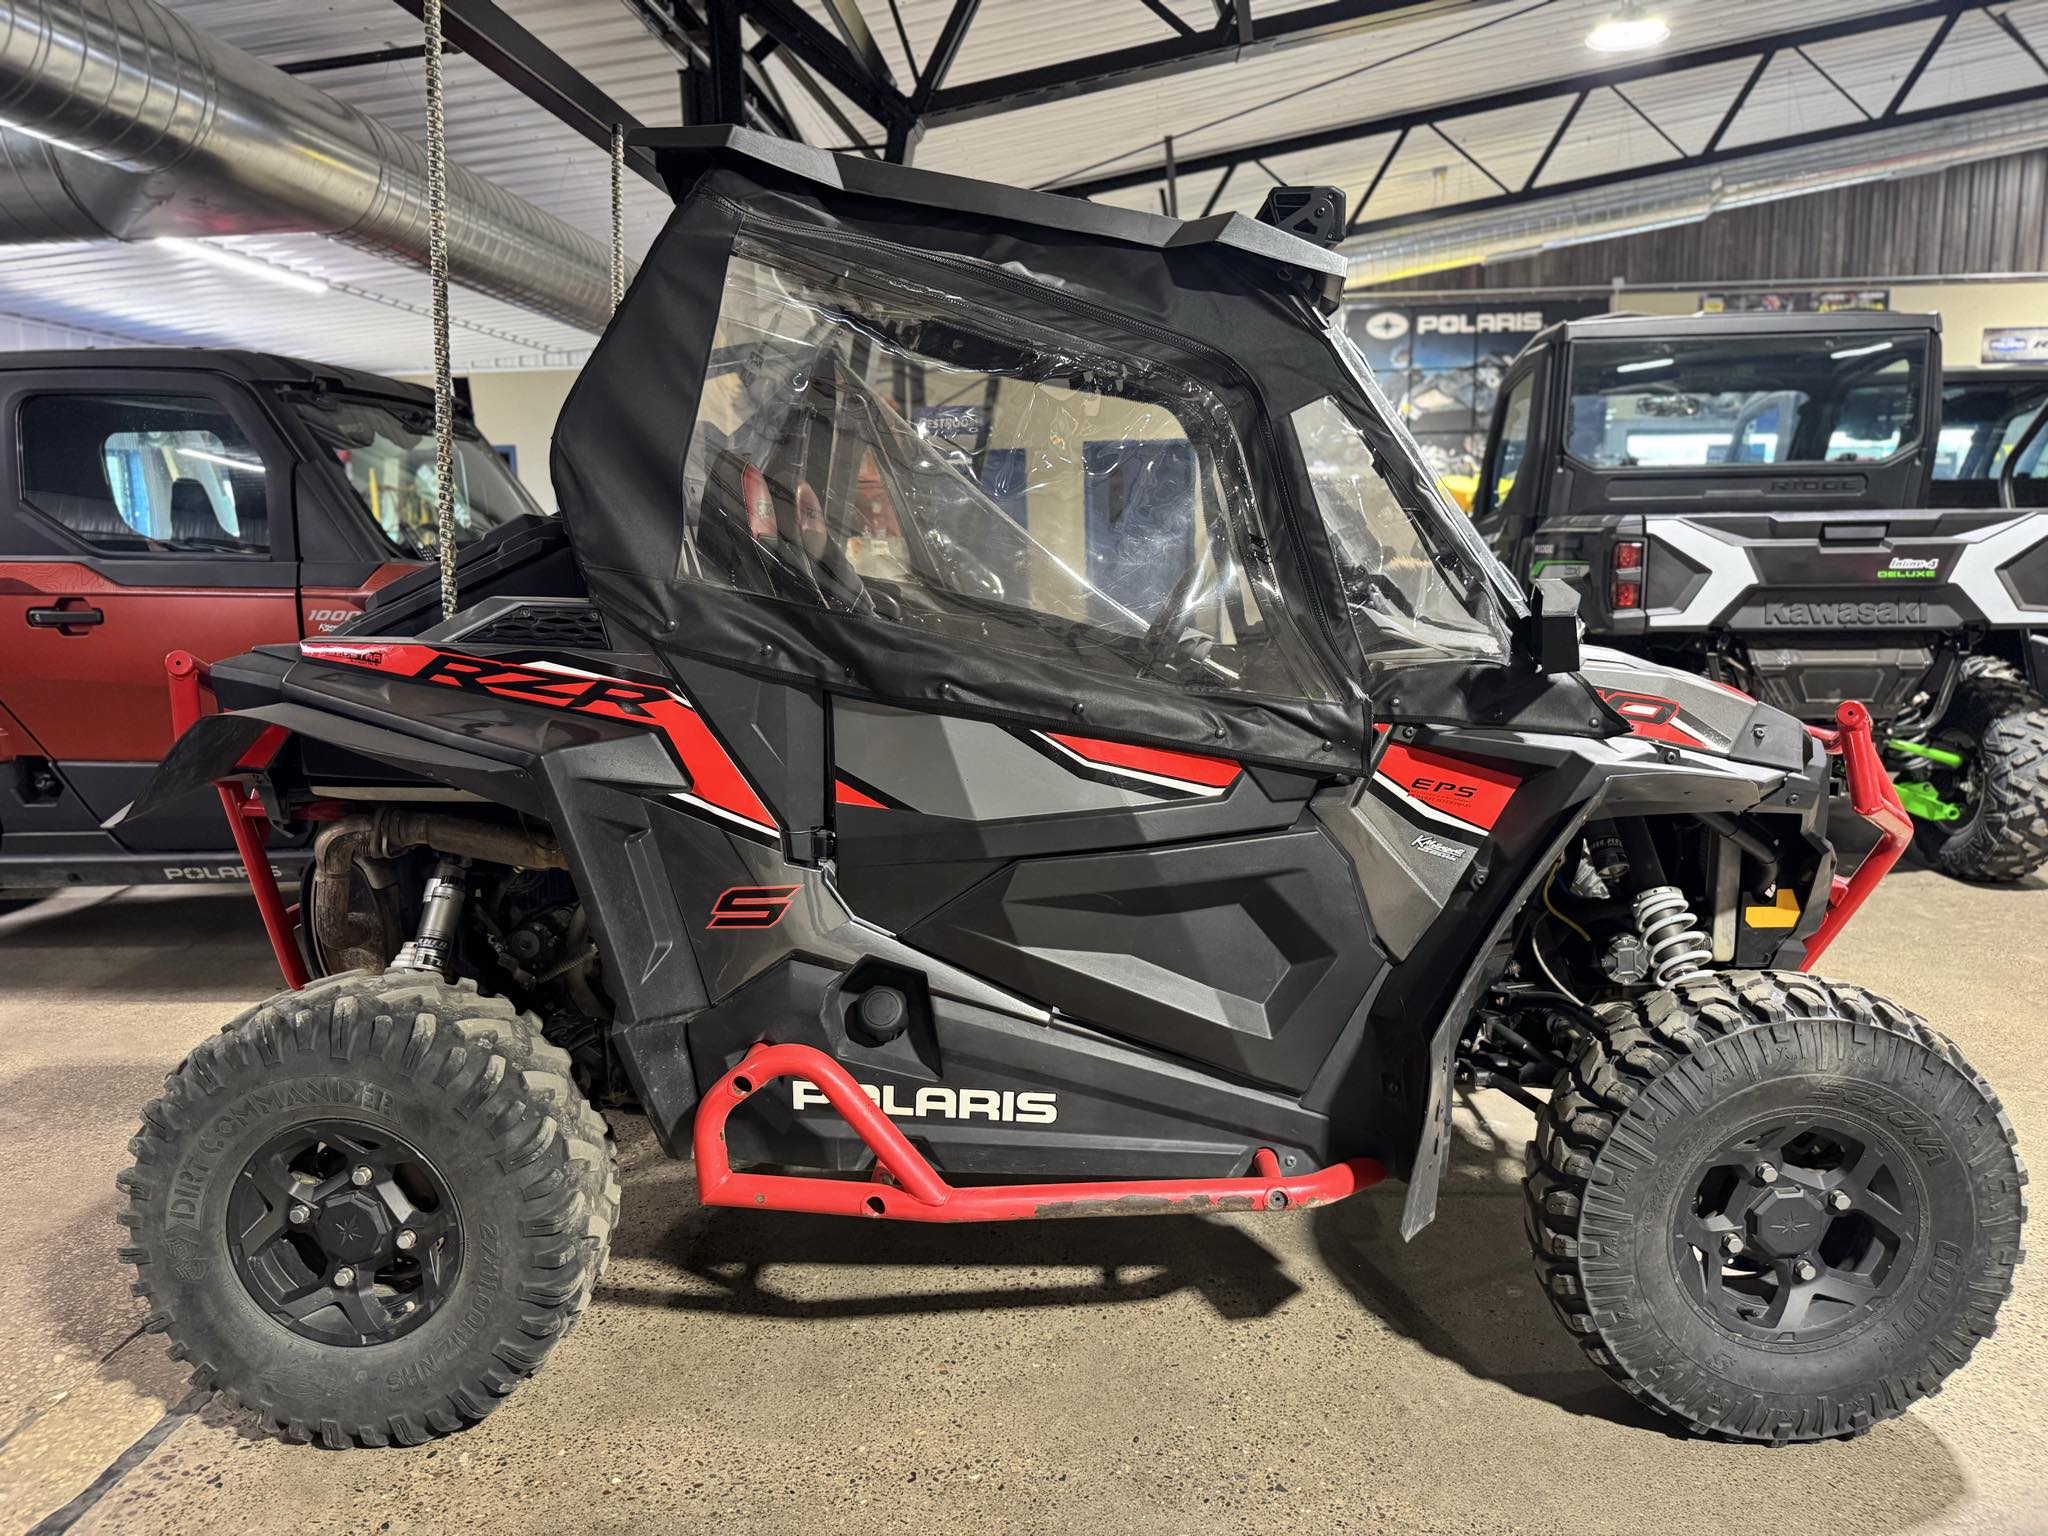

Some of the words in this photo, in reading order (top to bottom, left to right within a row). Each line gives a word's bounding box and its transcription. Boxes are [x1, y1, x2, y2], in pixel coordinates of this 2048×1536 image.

[1417, 311, 1543, 334] POLARIS
[1770, 479, 1857, 491] RIDGE
[1877, 570, 1937, 578] DELUXE
[1764, 600, 1928, 625] Kawasaki
[414, 653, 674, 718] RZR
[1411, 778, 1478, 799] EPS
[706, 885, 801, 929] S
[792, 1081, 1058, 1124] PLARIS
[168, 1155, 210, 1220] DIRT
[199, 1079, 396, 1154] COMMANDER
